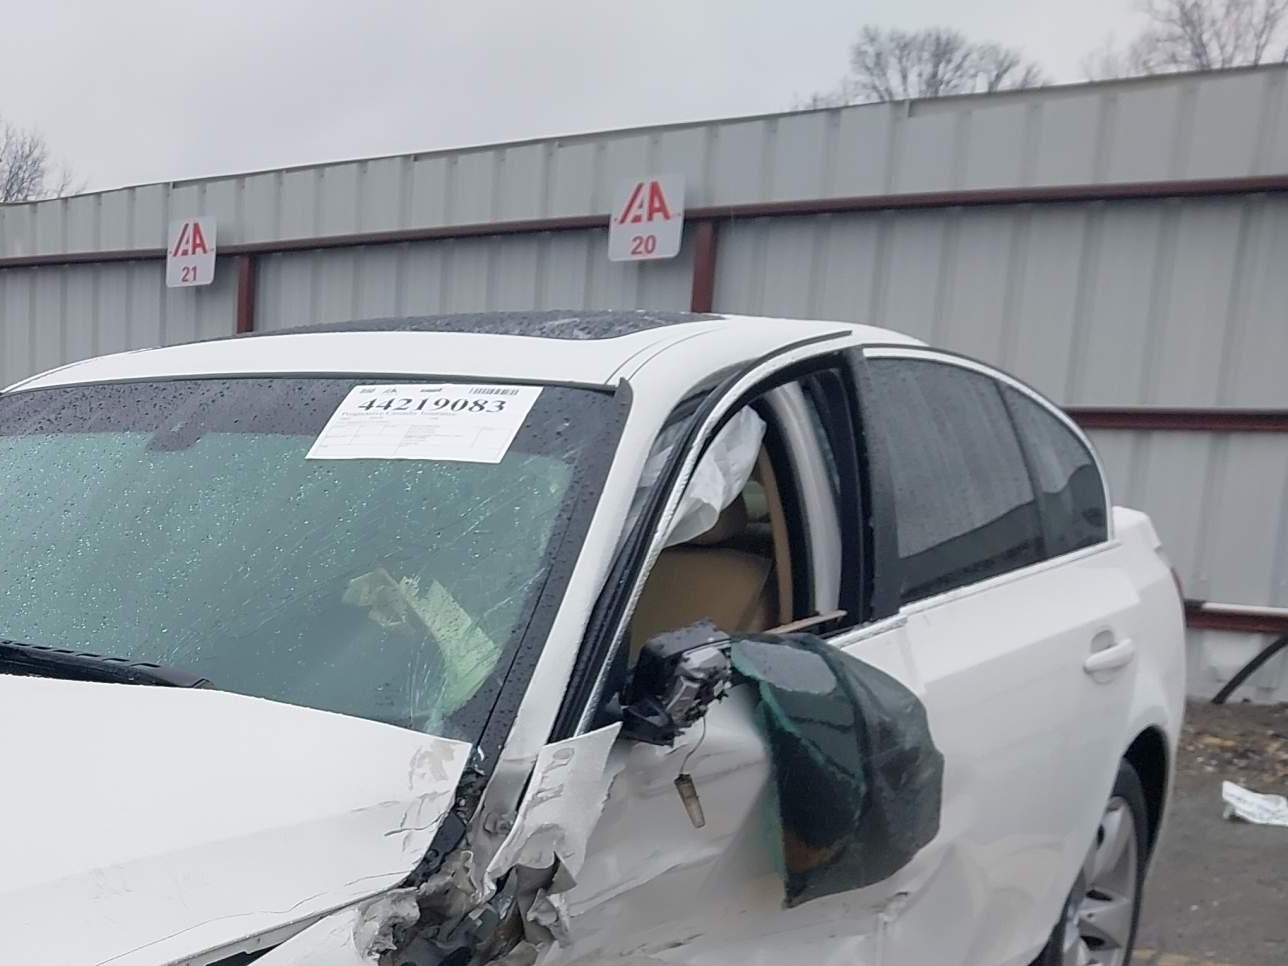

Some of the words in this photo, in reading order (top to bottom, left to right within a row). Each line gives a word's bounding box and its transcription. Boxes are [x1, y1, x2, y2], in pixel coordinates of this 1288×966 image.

[630, 235, 657, 256] 20
[181, 265, 198, 282] 21
[358, 397, 507, 413] 44219083
